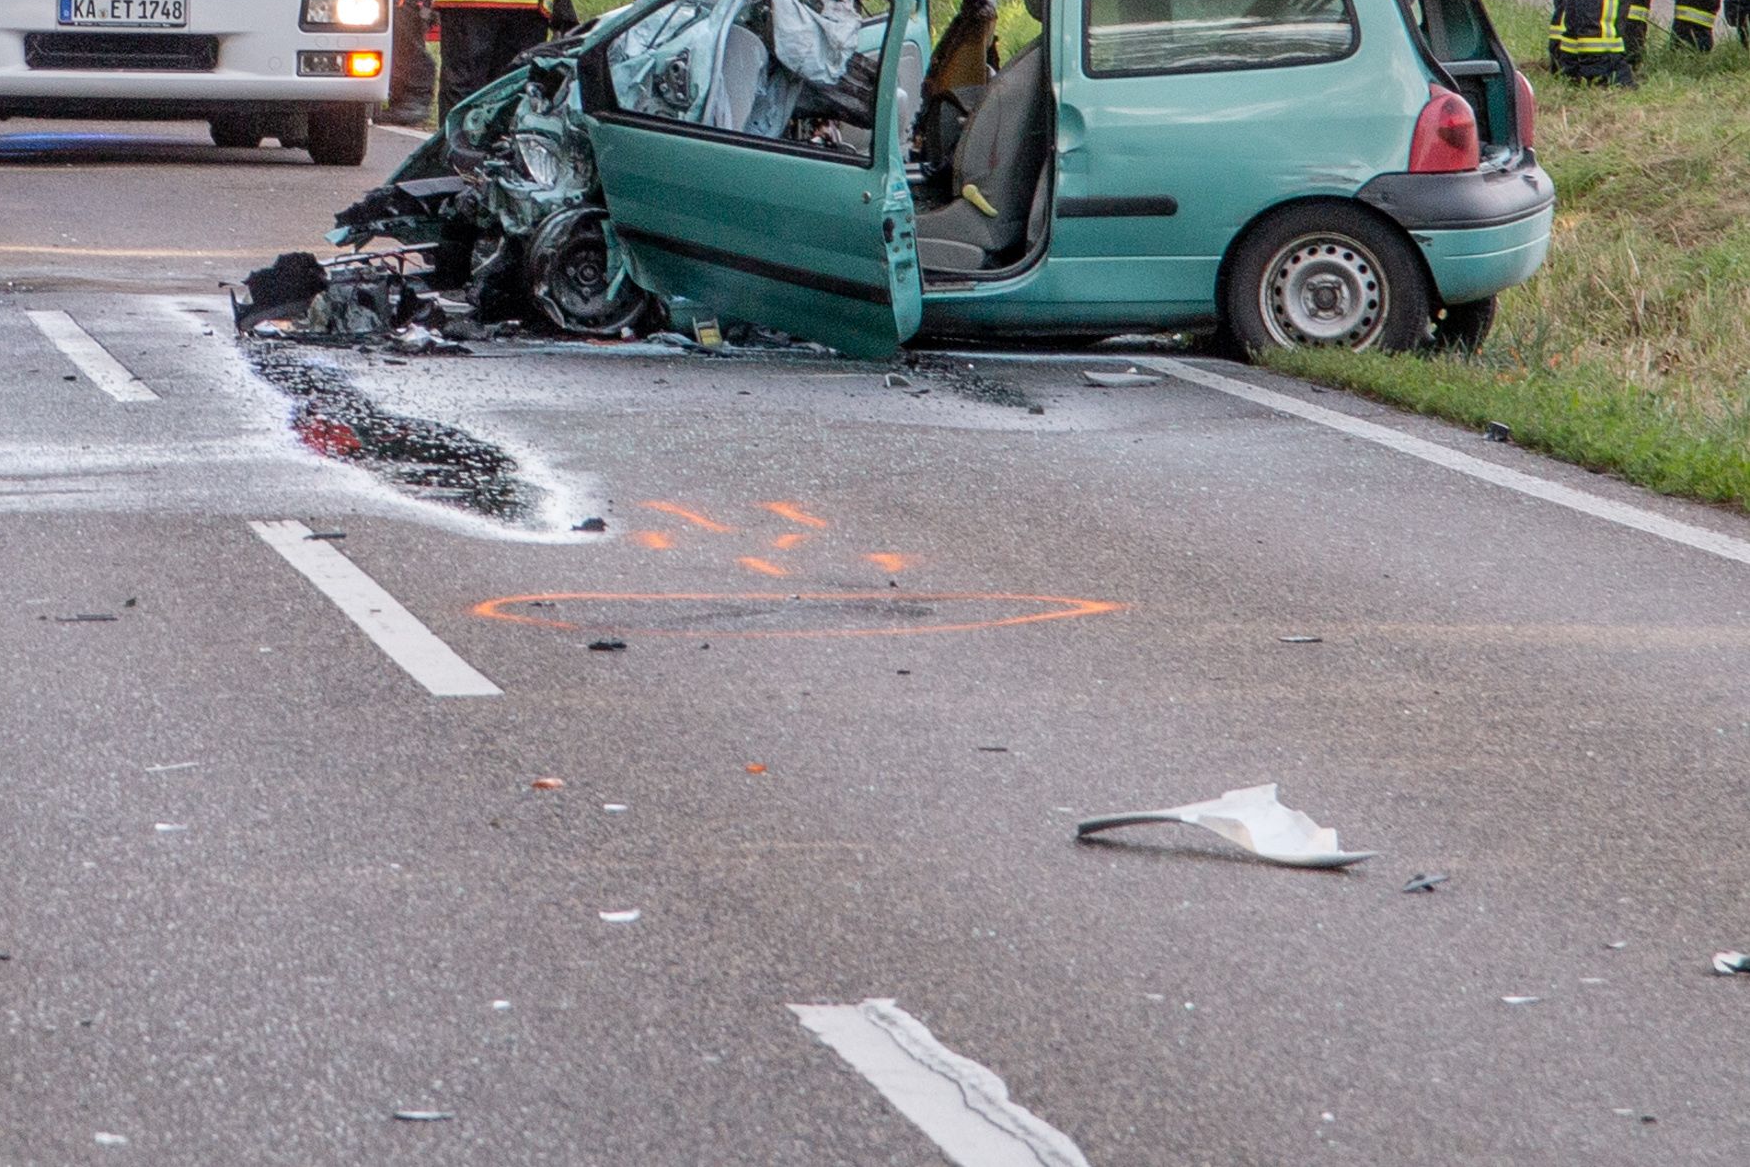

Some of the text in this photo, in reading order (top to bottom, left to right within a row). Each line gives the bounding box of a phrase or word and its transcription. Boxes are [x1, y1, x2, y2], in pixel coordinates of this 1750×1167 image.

[73, 0, 183, 20] KA ET 1748
